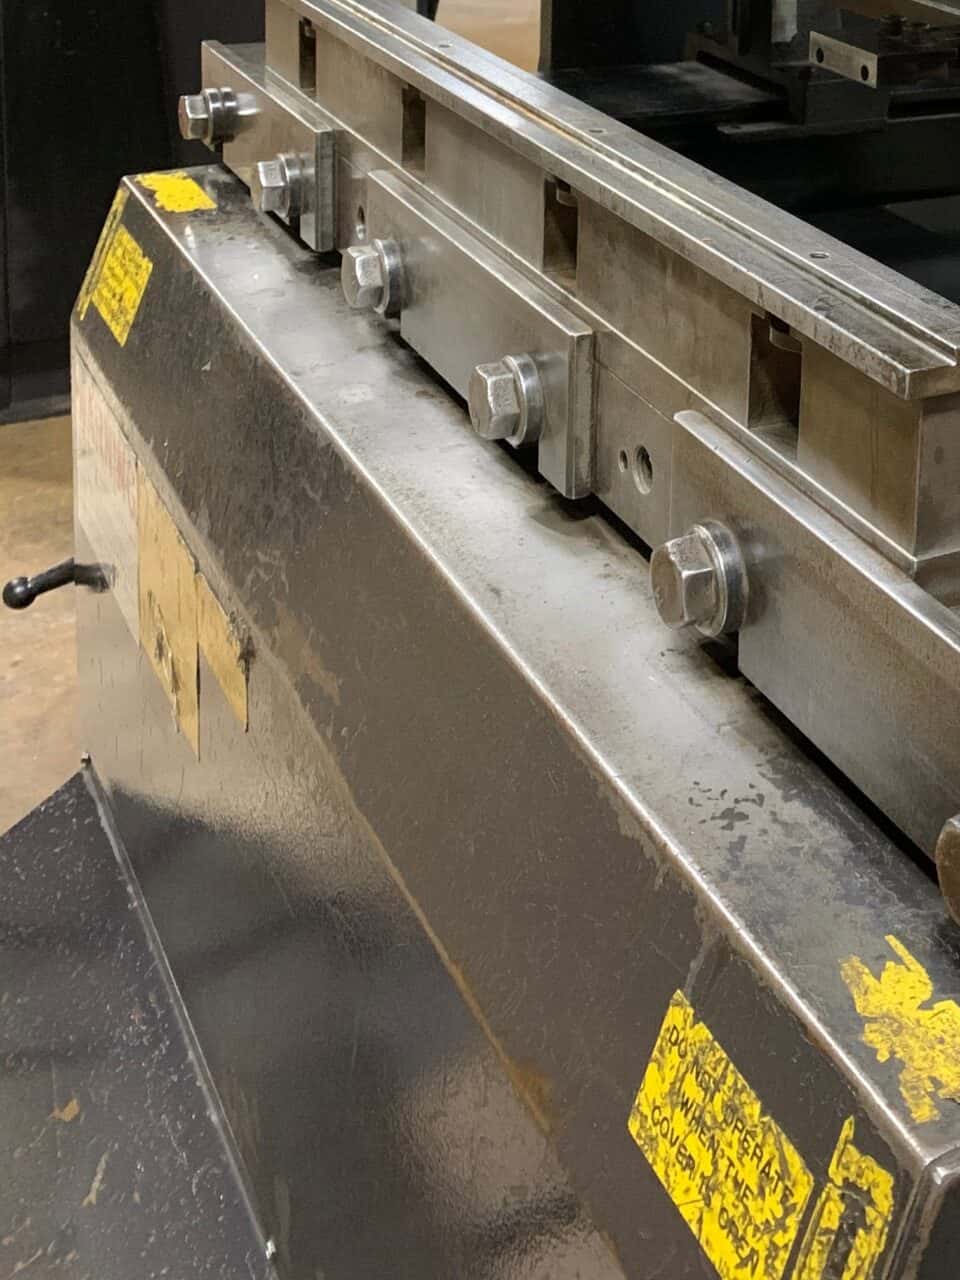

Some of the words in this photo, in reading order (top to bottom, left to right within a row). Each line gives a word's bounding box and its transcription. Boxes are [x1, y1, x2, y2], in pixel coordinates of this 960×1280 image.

[650, 1104, 696, 1180] COVER
[717, 1206, 760, 1277] OPEN
[668, 1024, 688, 1059] DO
[723, 1103, 796, 1205] OPERATE
[680, 1093, 720, 1160] WHEN
[722, 1156, 755, 1204] THE
